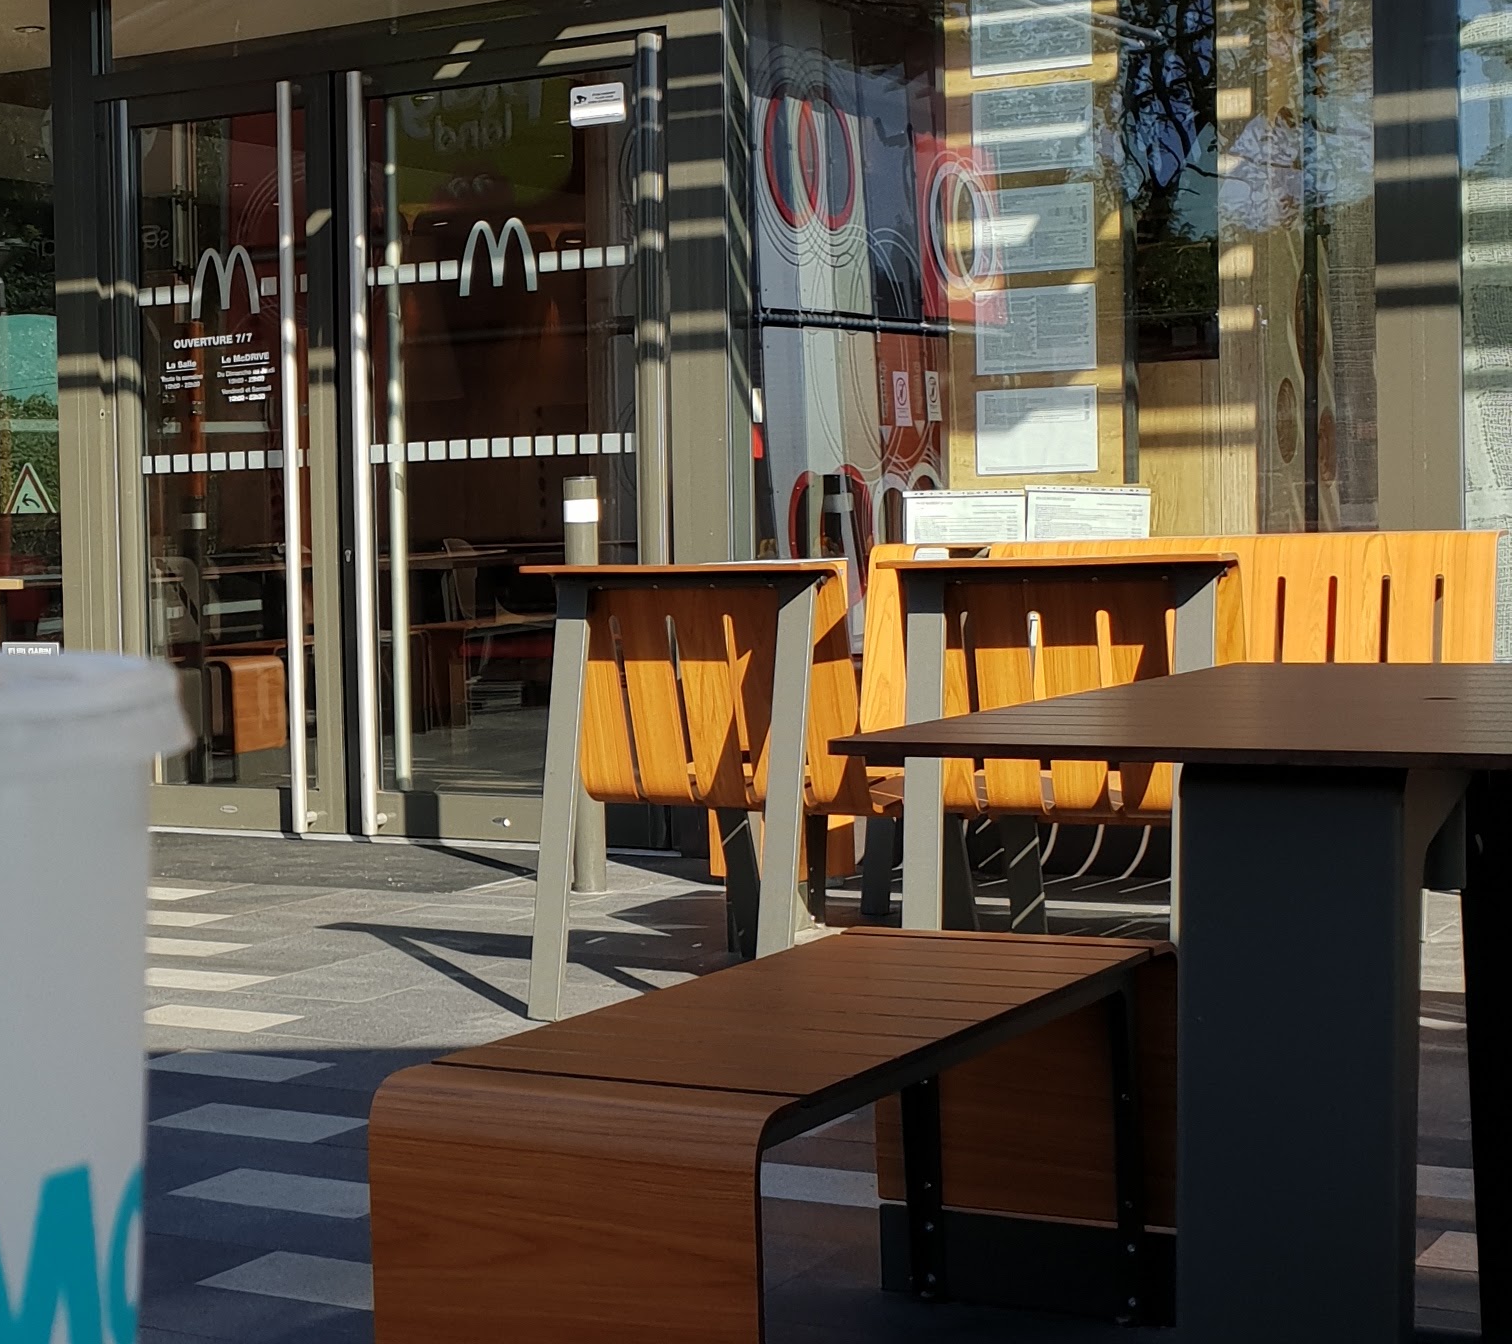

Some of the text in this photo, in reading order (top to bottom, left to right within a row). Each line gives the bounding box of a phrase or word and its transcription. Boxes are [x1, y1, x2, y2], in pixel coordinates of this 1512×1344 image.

[173, 333, 253, 349] OUVERTURE 7/7
[233, 351, 270, 363] McDRIVE
